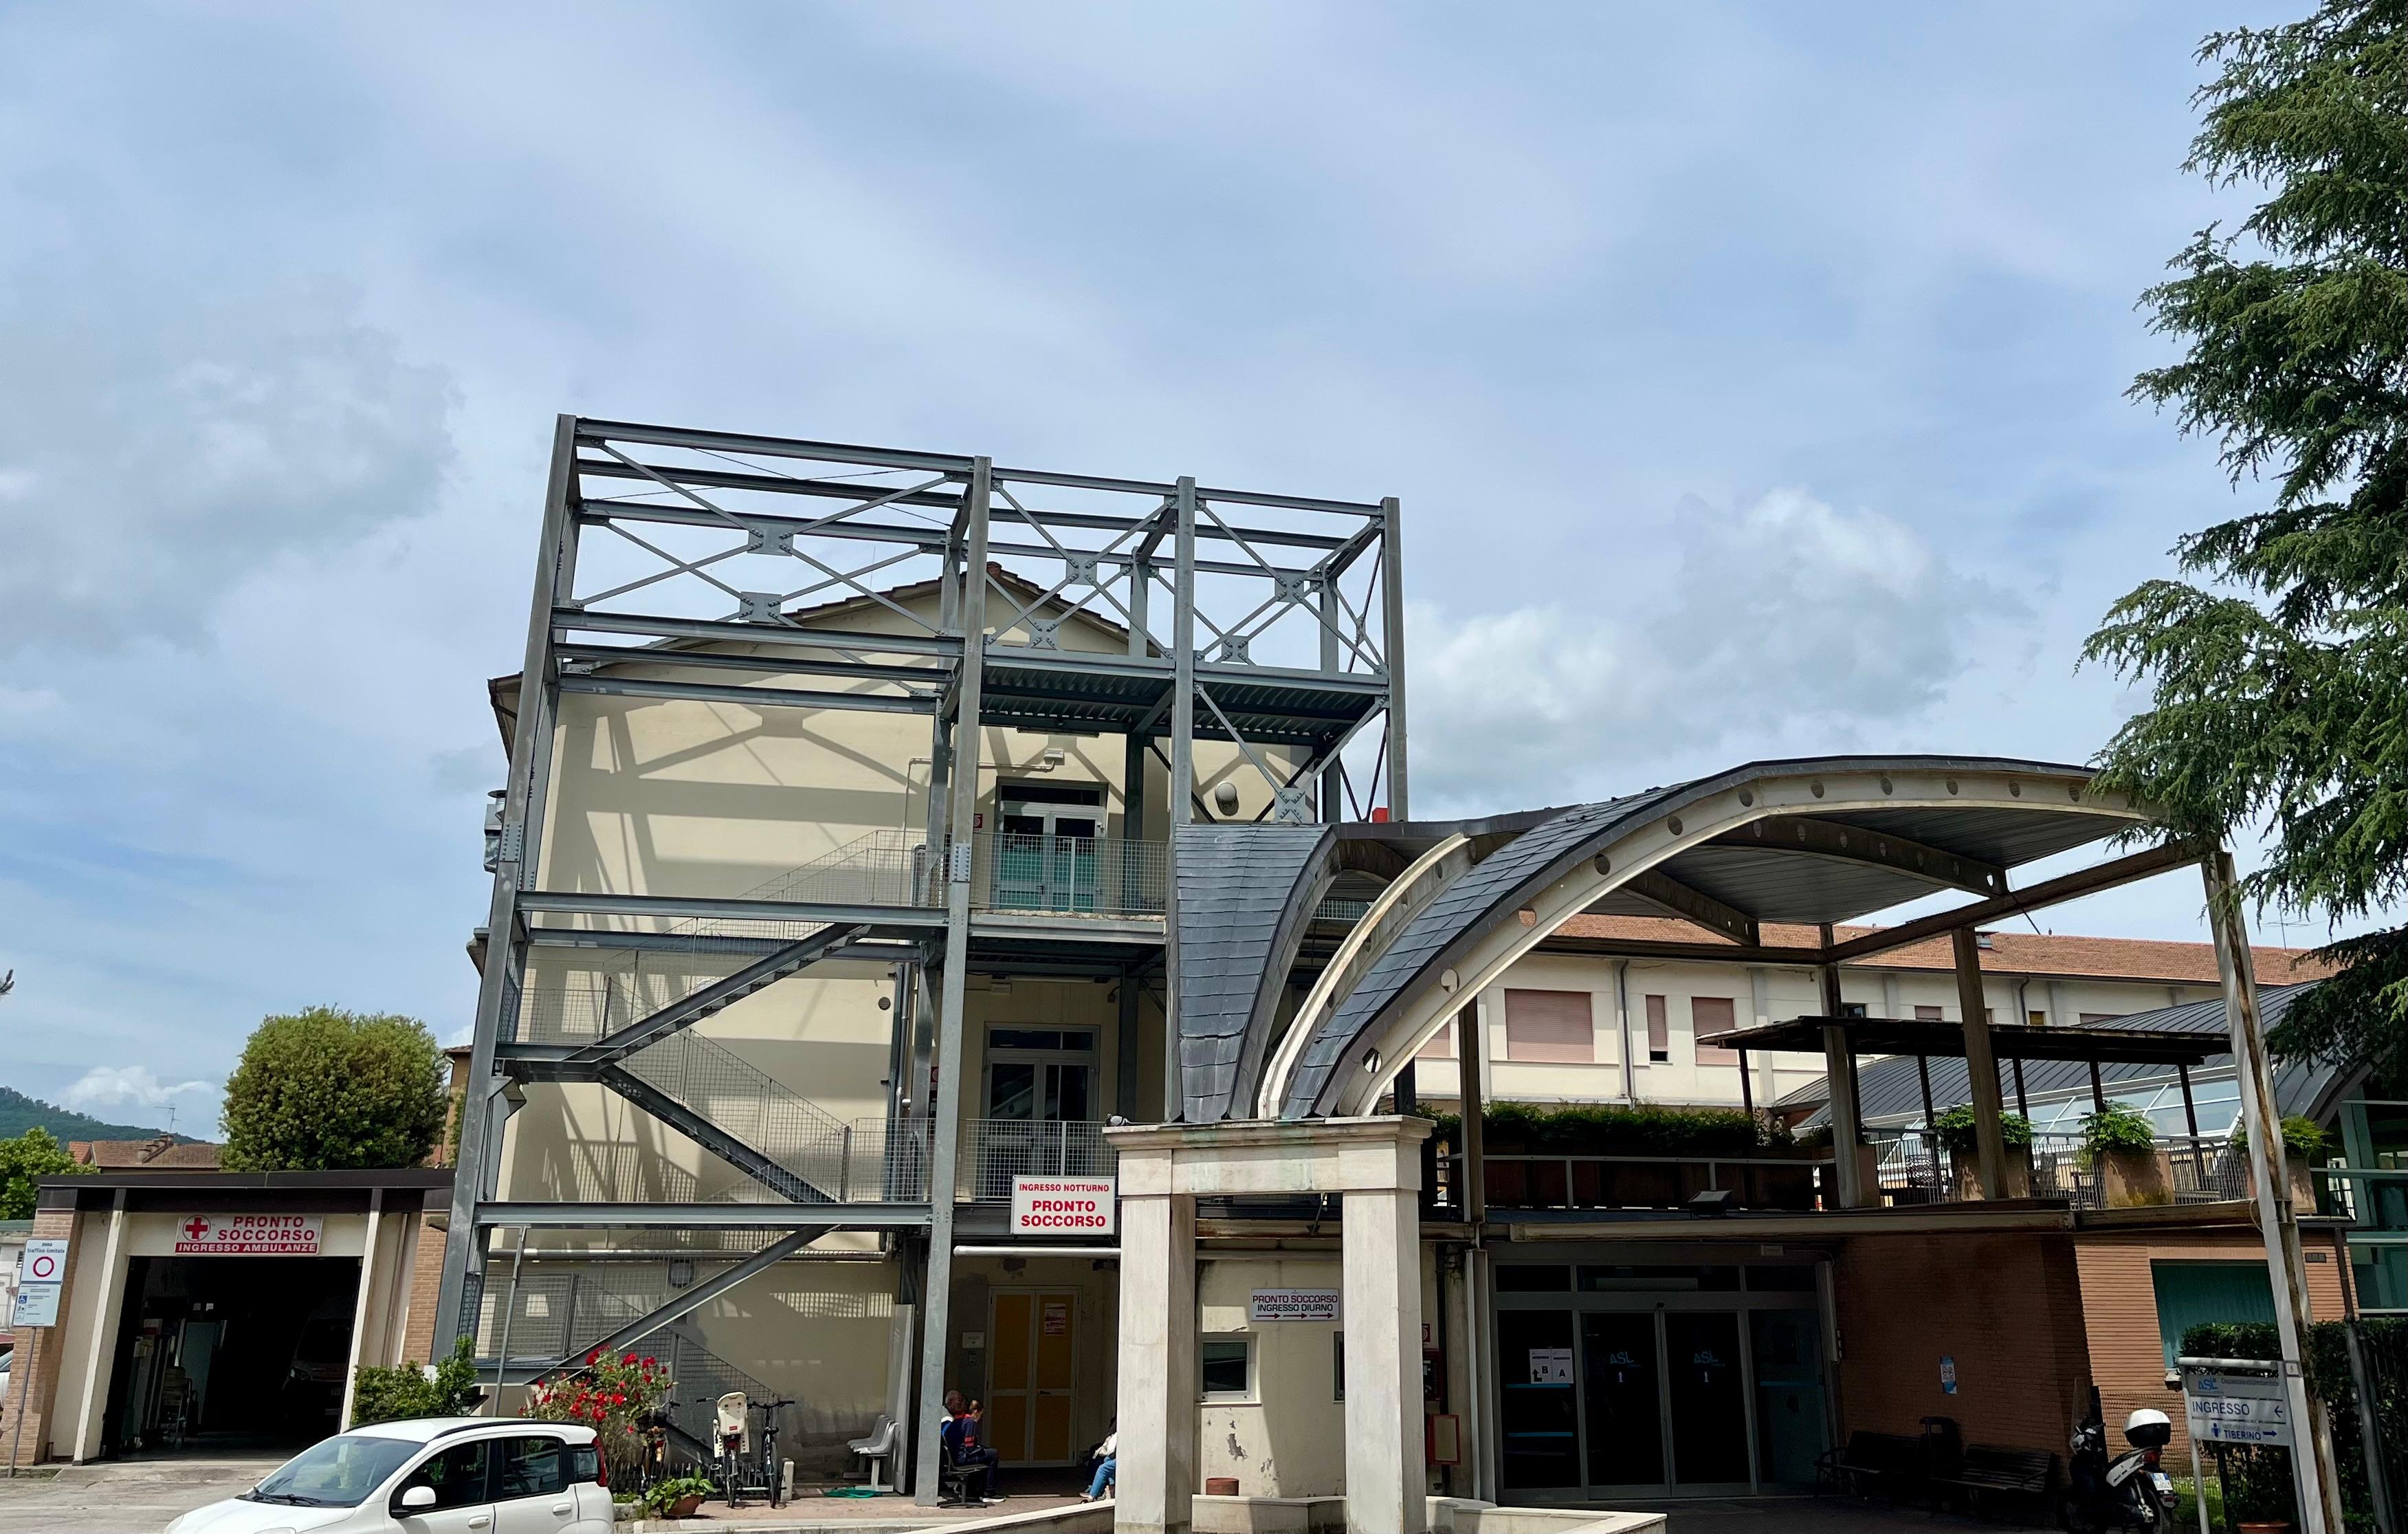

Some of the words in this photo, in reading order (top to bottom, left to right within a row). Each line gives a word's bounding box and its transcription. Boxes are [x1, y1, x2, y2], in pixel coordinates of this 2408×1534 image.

[1019, 1183, 1061, 1192] INGRESSO
[1063, 1184, 1109, 1192] NOTTURNO
[1032, 1200, 1096, 1212] PRONTO
[232, 1216, 305, 1227] PRONTO
[1021, 1215, 1106, 1227] SOCCORSO
[217, 1229, 315, 1240] SOCCORSO
[178, 1243, 240, 1252] INGRESSO
[243, 1243, 316, 1252] AMBULANZE
[1559, 1369, 1565, 1377] A
[2191, 1401, 2250, 1416] INGRESSO
[2224, 1429, 2262, 1441] TIBERINO
